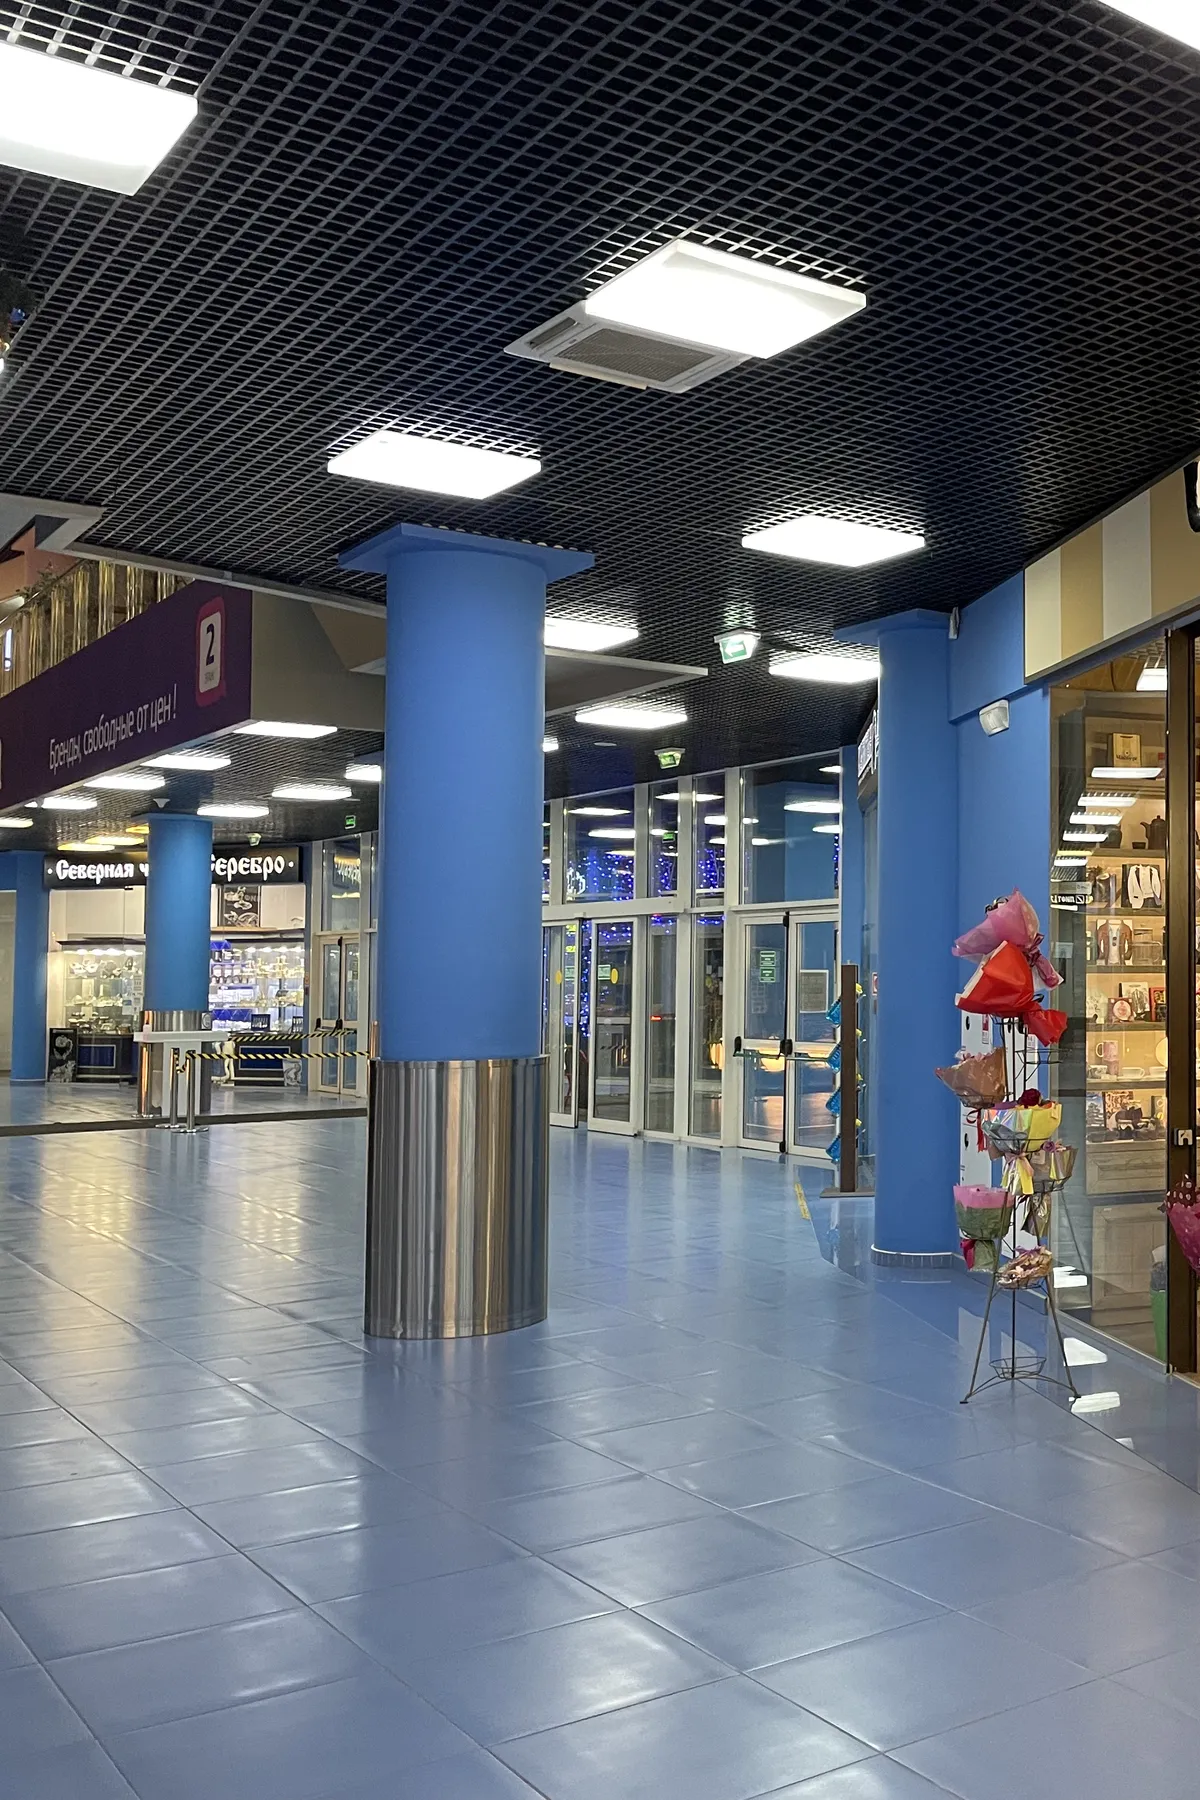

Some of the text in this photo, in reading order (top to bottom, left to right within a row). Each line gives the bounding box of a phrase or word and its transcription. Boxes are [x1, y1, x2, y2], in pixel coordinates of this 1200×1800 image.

[206, 623, 214, 666] 2
[49, 733, 82, 775] Бренды,
[83, 710, 134, 756] свободные
[136, 704, 149, 733] от
